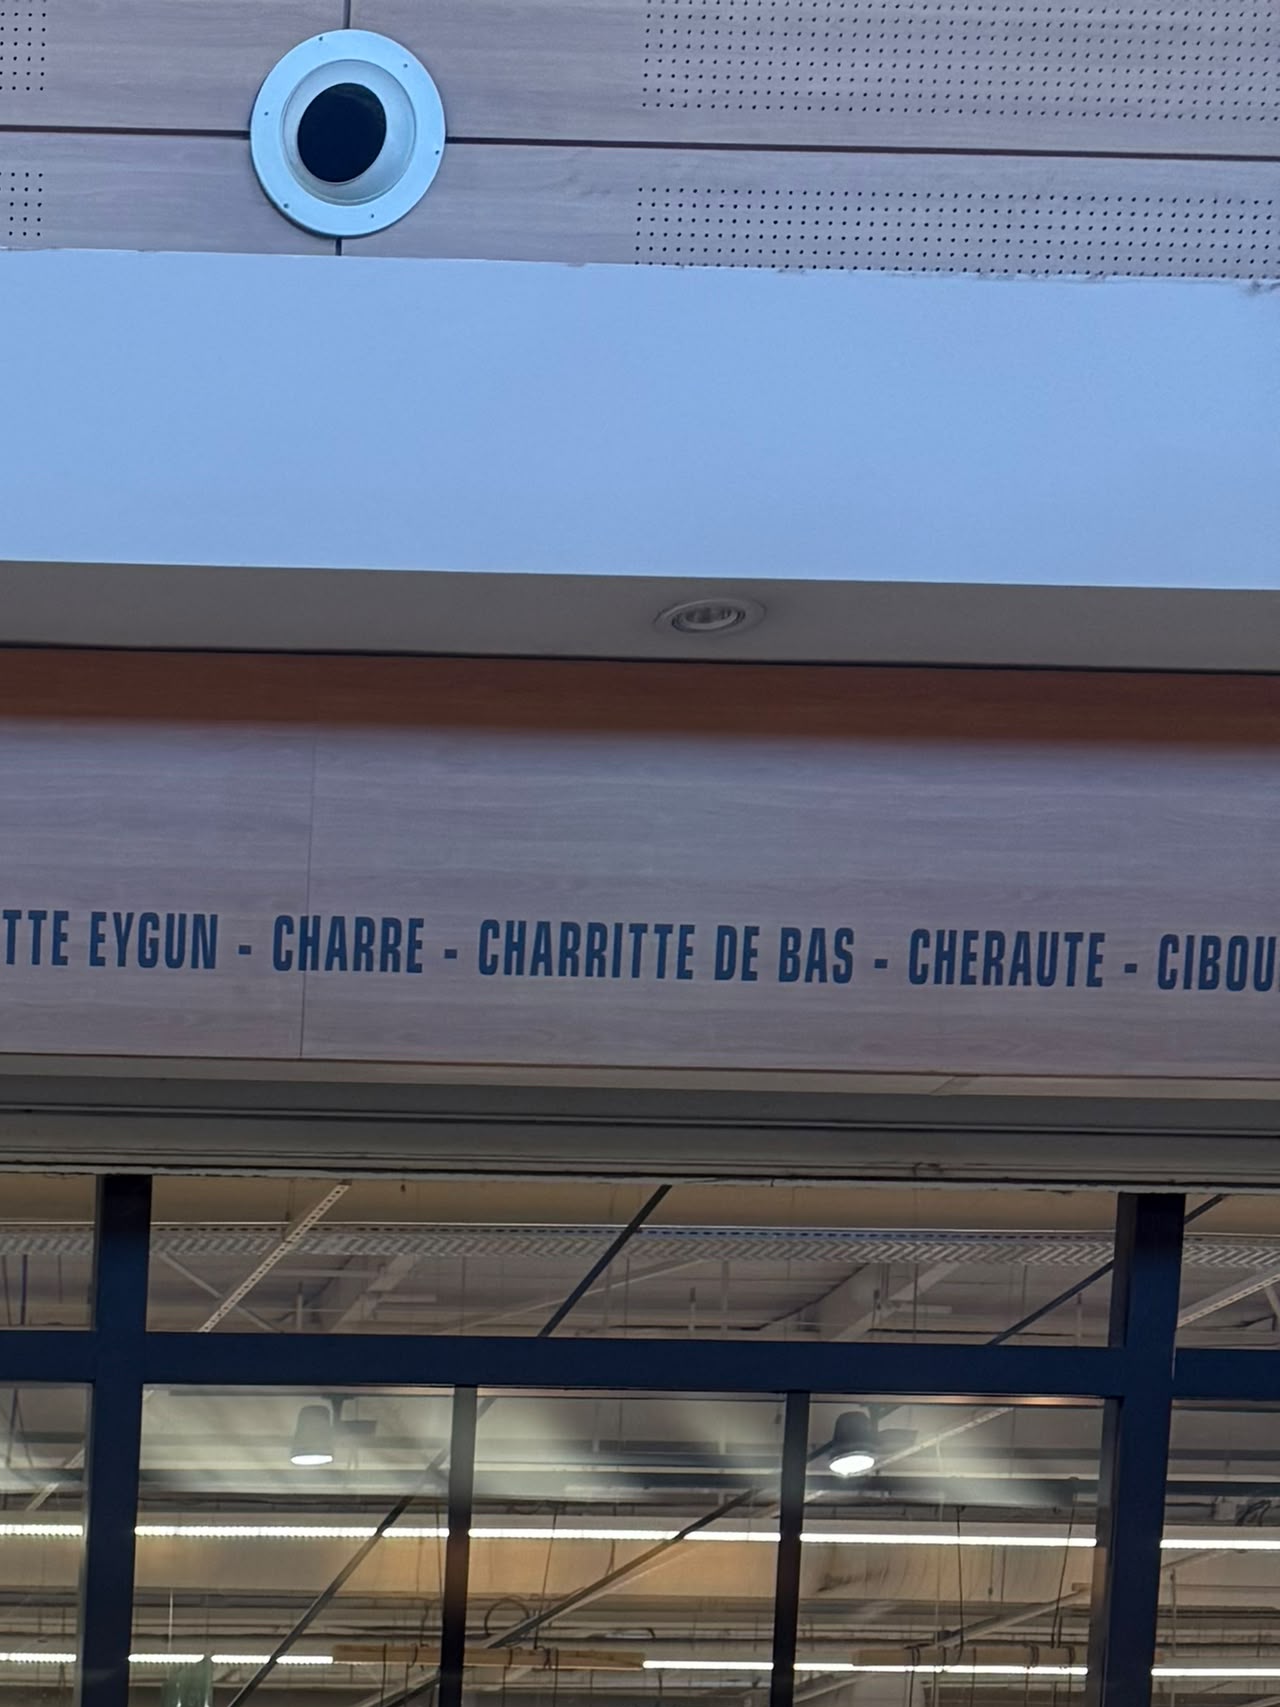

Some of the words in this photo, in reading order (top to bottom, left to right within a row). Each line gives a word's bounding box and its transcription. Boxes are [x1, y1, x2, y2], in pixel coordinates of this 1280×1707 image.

[88, 911, 218, 970] EYGUN
[272, 914, 425, 974] CHARRE
[477, 918, 696, 981] CHARRITTE
[713, 924, 760, 982] DE
[777, 926, 855, 984] BAS
[907, 929, 1106, 988] CHERAUTE
[1156, 933, 1280, 993] CIBOU
